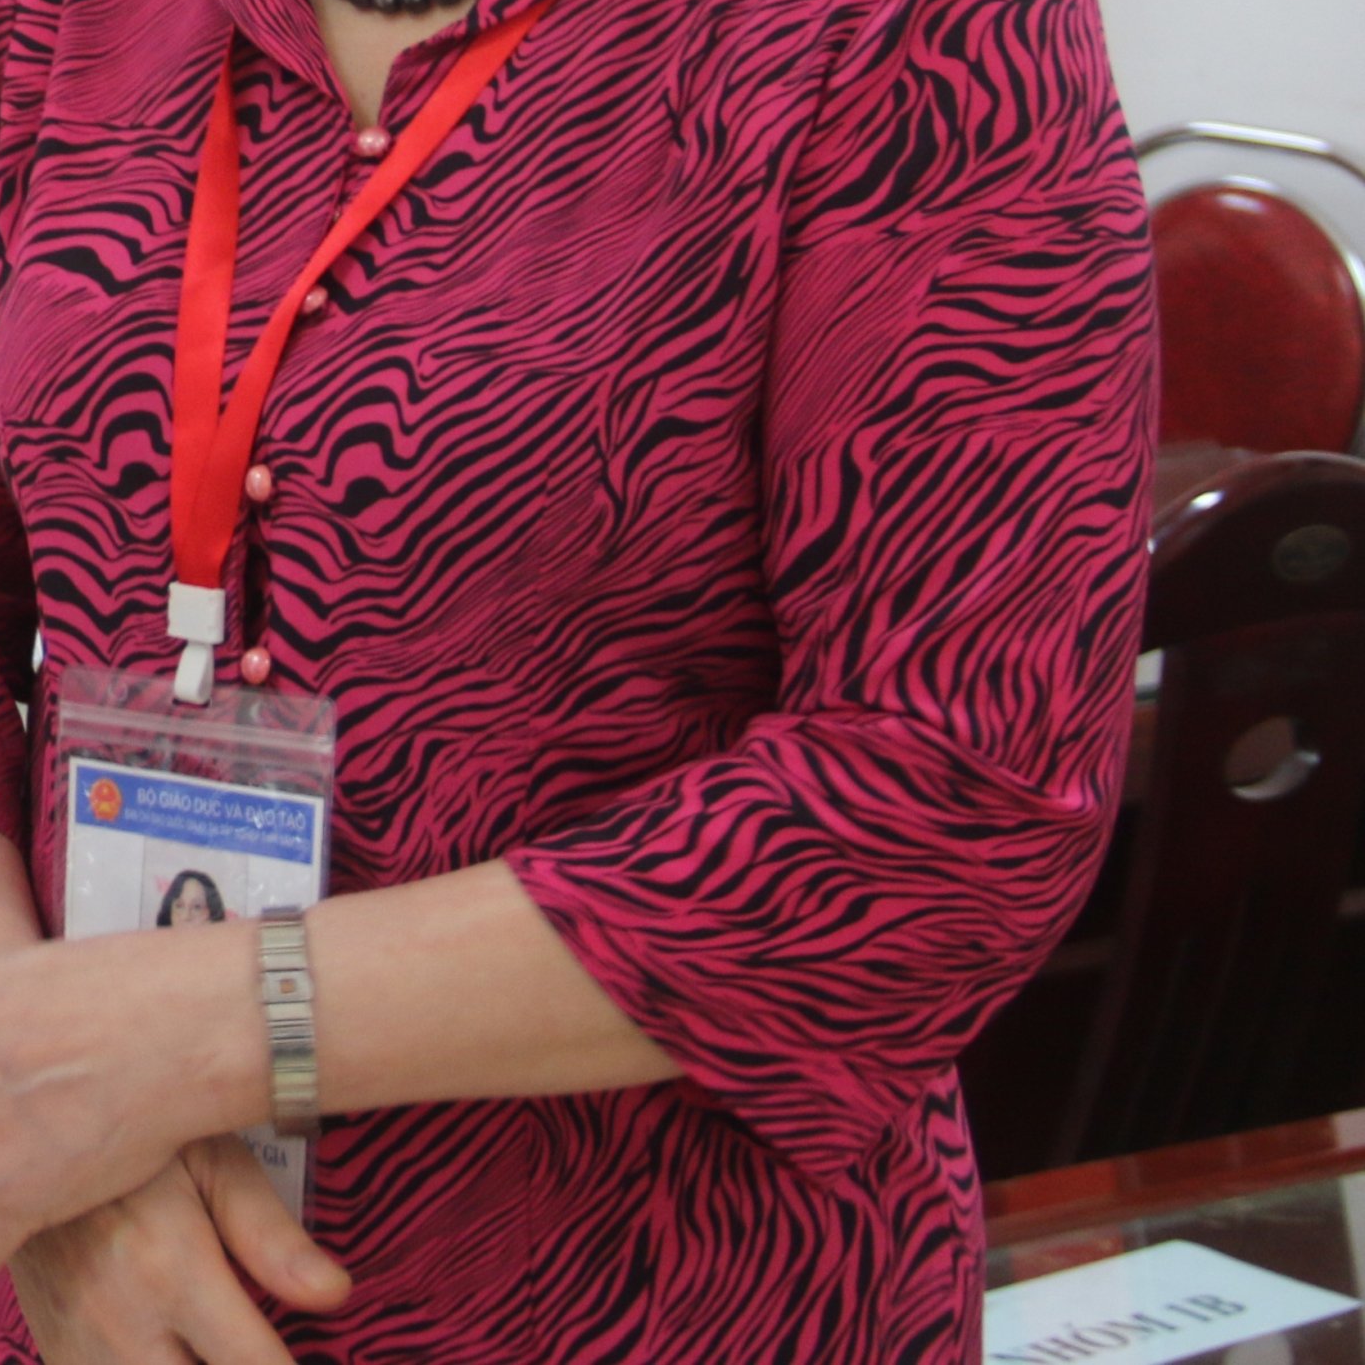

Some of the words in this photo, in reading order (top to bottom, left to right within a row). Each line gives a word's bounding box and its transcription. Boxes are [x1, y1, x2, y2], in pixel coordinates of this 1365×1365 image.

[137, 787, 157, 806] BỘ
[159, 790, 192, 812] GIÁO
[193, 797, 221, 819] DỤC
[224, 802, 244, 820] VÀ
[1165, 1293, 1247, 1323] 1B
